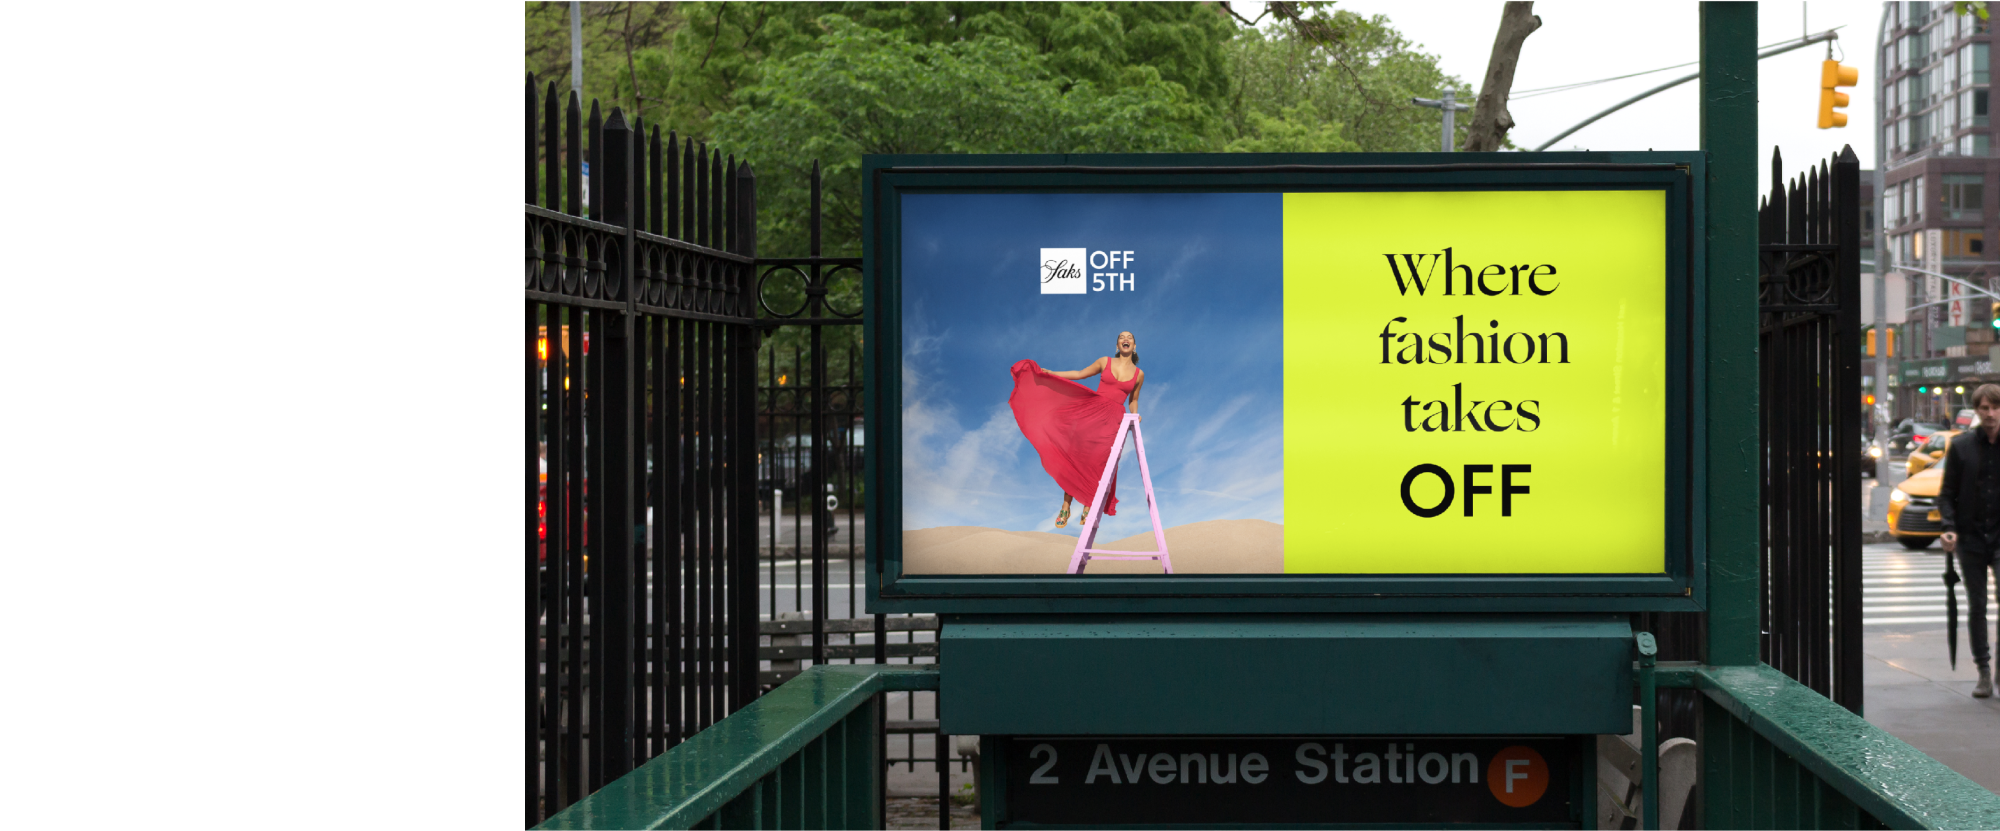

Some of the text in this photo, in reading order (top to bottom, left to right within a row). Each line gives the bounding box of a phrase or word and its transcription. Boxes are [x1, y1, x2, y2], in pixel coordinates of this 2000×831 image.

[1041, 259, 1082, 284] Saks
[1090, 250, 1135, 270] OFF
[1092, 272, 1135, 292] 5TH
[1383, 247, 1561, 297] Where
[1379, 314, 1571, 365] fashion
[1401, 382, 1541, 433] takes
[1400, 463, 1532, 519] OFF
[1029, 742, 1531, 793] 2 Avenue Station F
